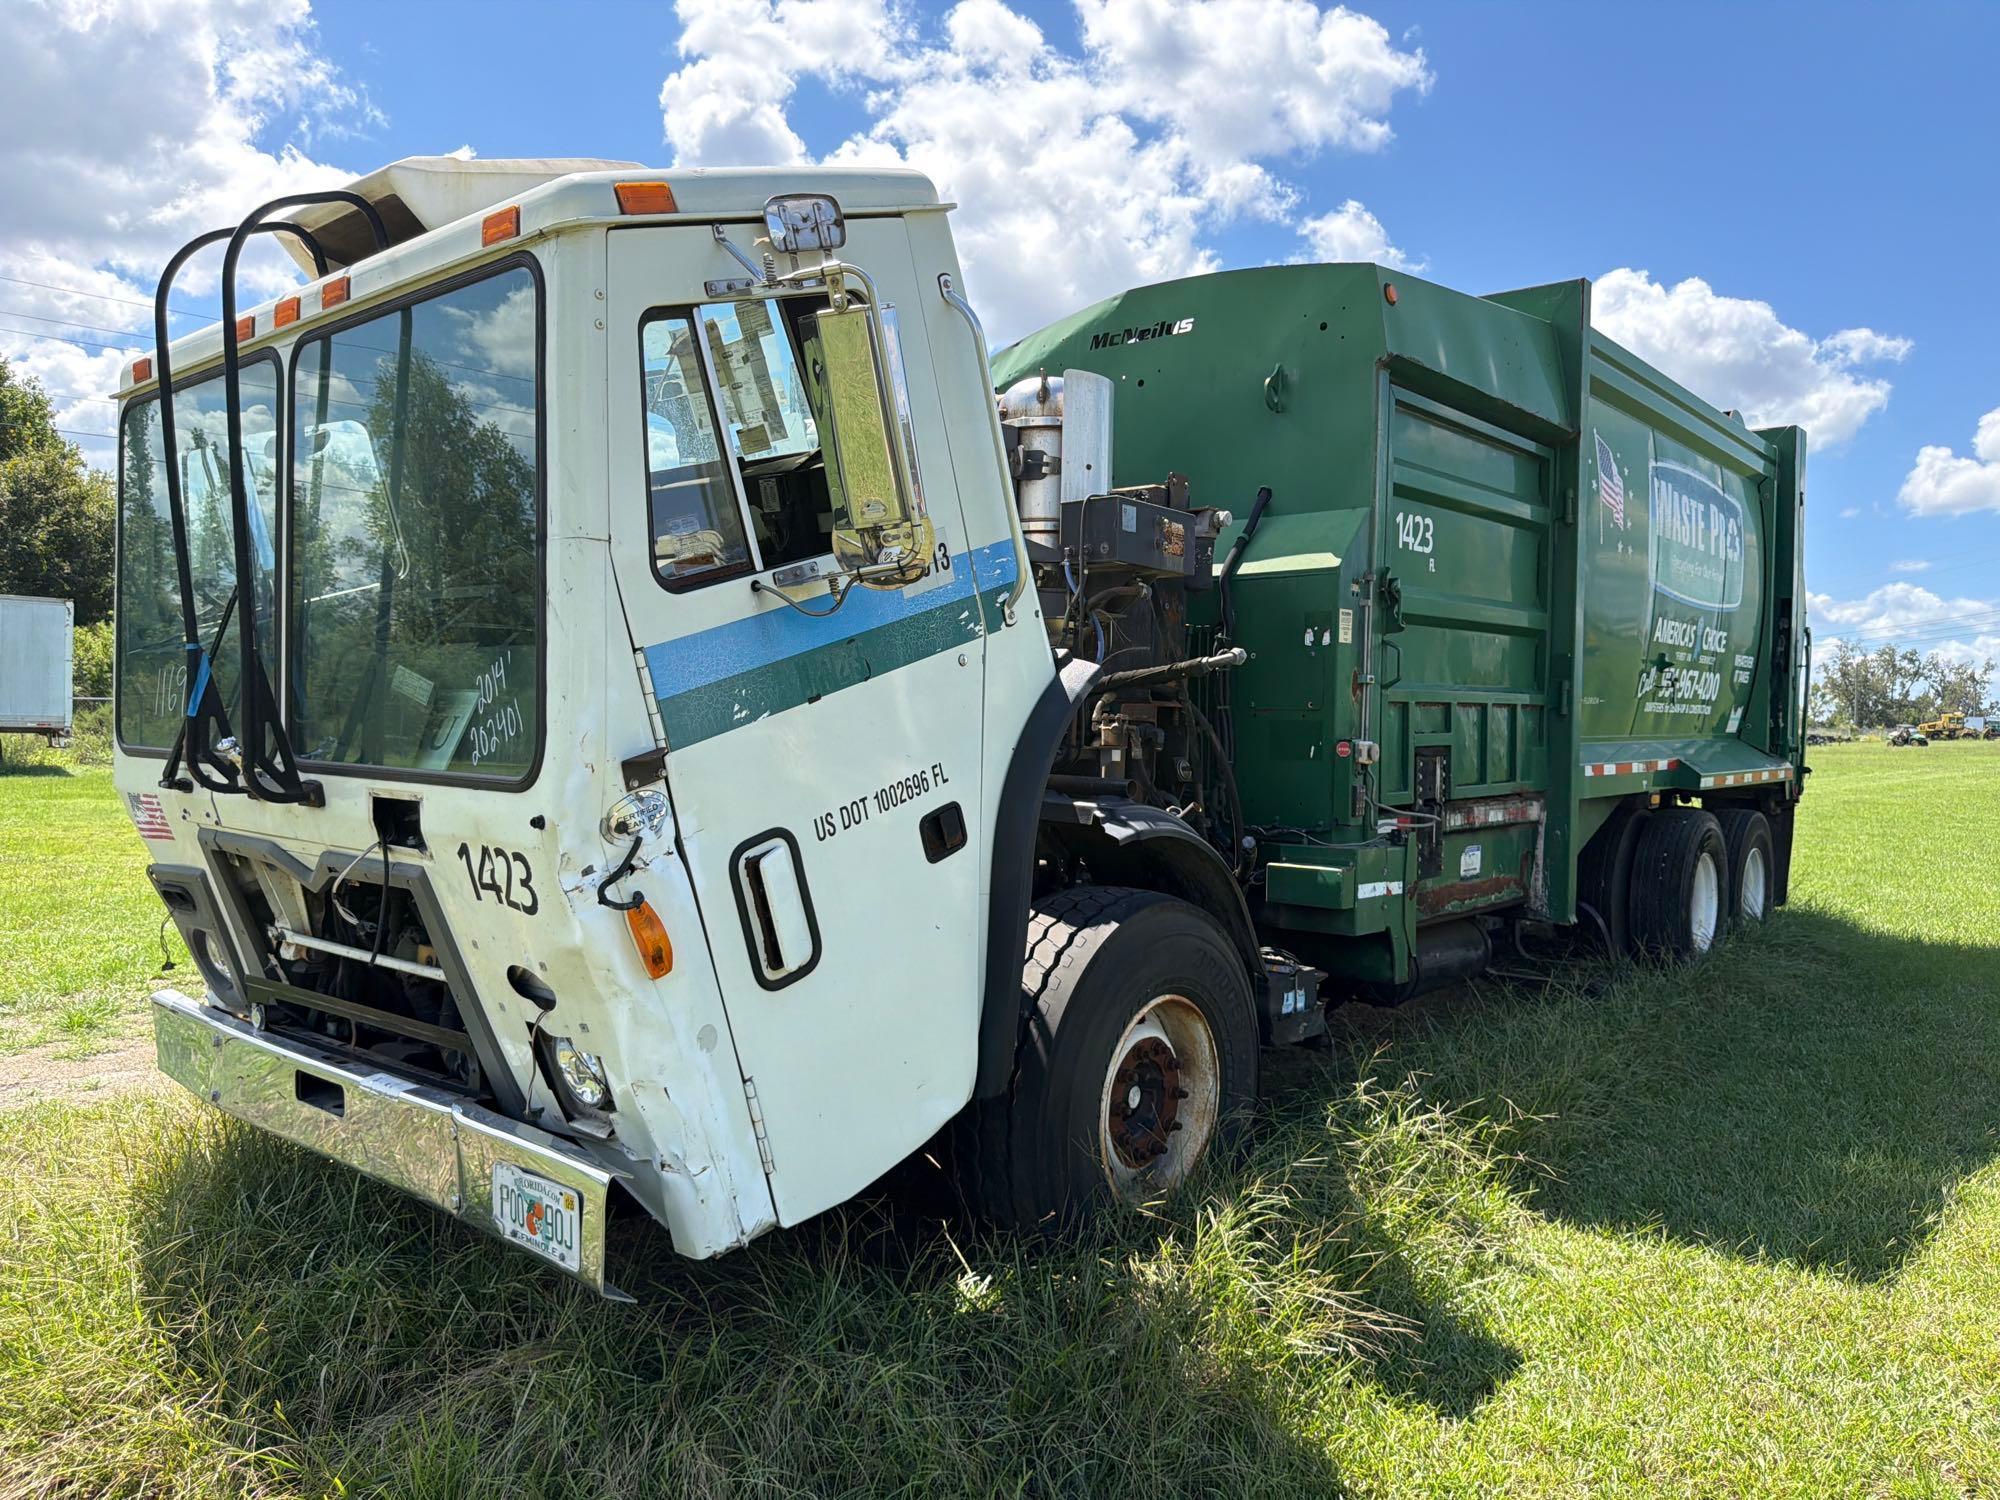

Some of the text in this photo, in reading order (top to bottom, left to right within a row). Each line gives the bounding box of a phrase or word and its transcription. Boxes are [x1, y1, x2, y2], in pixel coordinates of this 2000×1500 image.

[1089, 318, 1195, 351] McNeilus
[1396, 512, 1433, 554] 1423
[1653, 477, 1705, 552] WASTE
[1702, 626, 1728, 653] CHOICE
[154, 665, 187, 718] 1169
[470, 697, 523, 766] 202401
[617, 804, 659, 824] CERTIFIED
[813, 762, 949, 842] US DOT 1002696 FL
[457, 842, 539, 916] 1423
